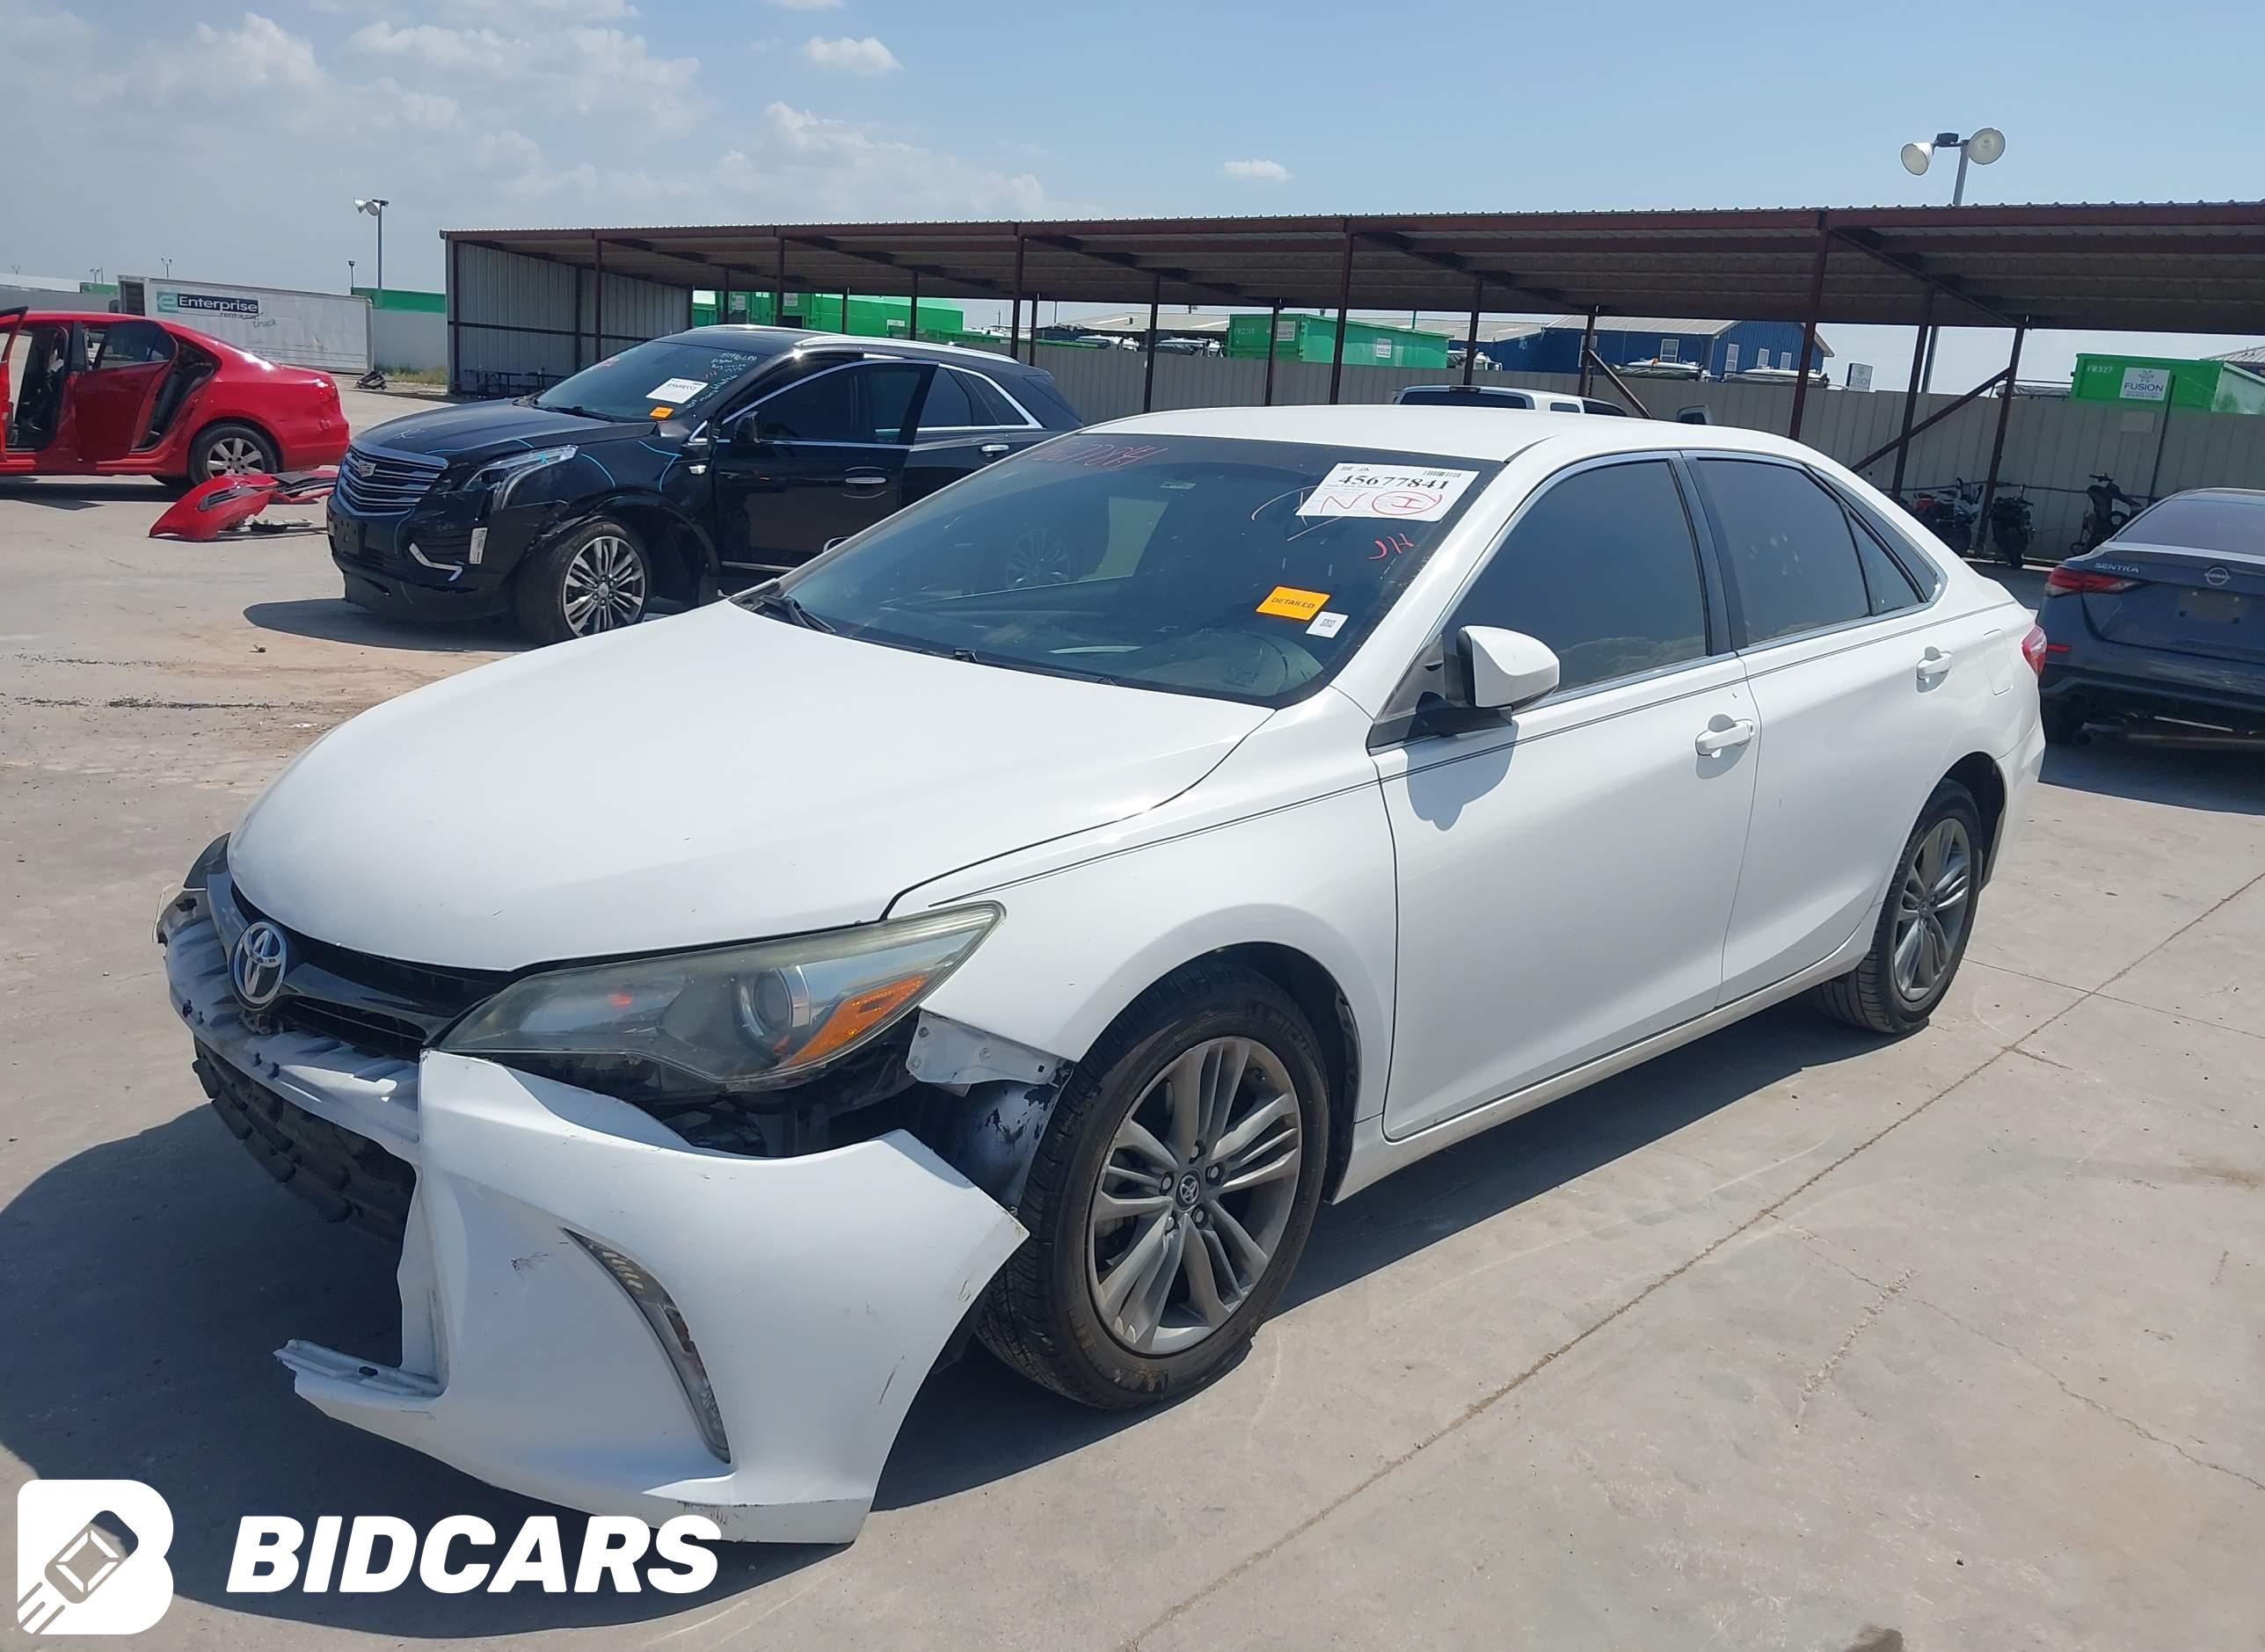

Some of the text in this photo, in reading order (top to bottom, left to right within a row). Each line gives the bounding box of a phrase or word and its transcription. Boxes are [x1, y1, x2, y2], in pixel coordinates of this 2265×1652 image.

[178, 295, 258, 311] Enterprise
[252, 318, 278, 328] truck
[2123, 382, 2164, 391] FUSION
[1337, 475, 1449, 490] 45677841
[2094, 562, 2139, 573] SENTRA
[1271, 597, 1315, 608] DETAILED
